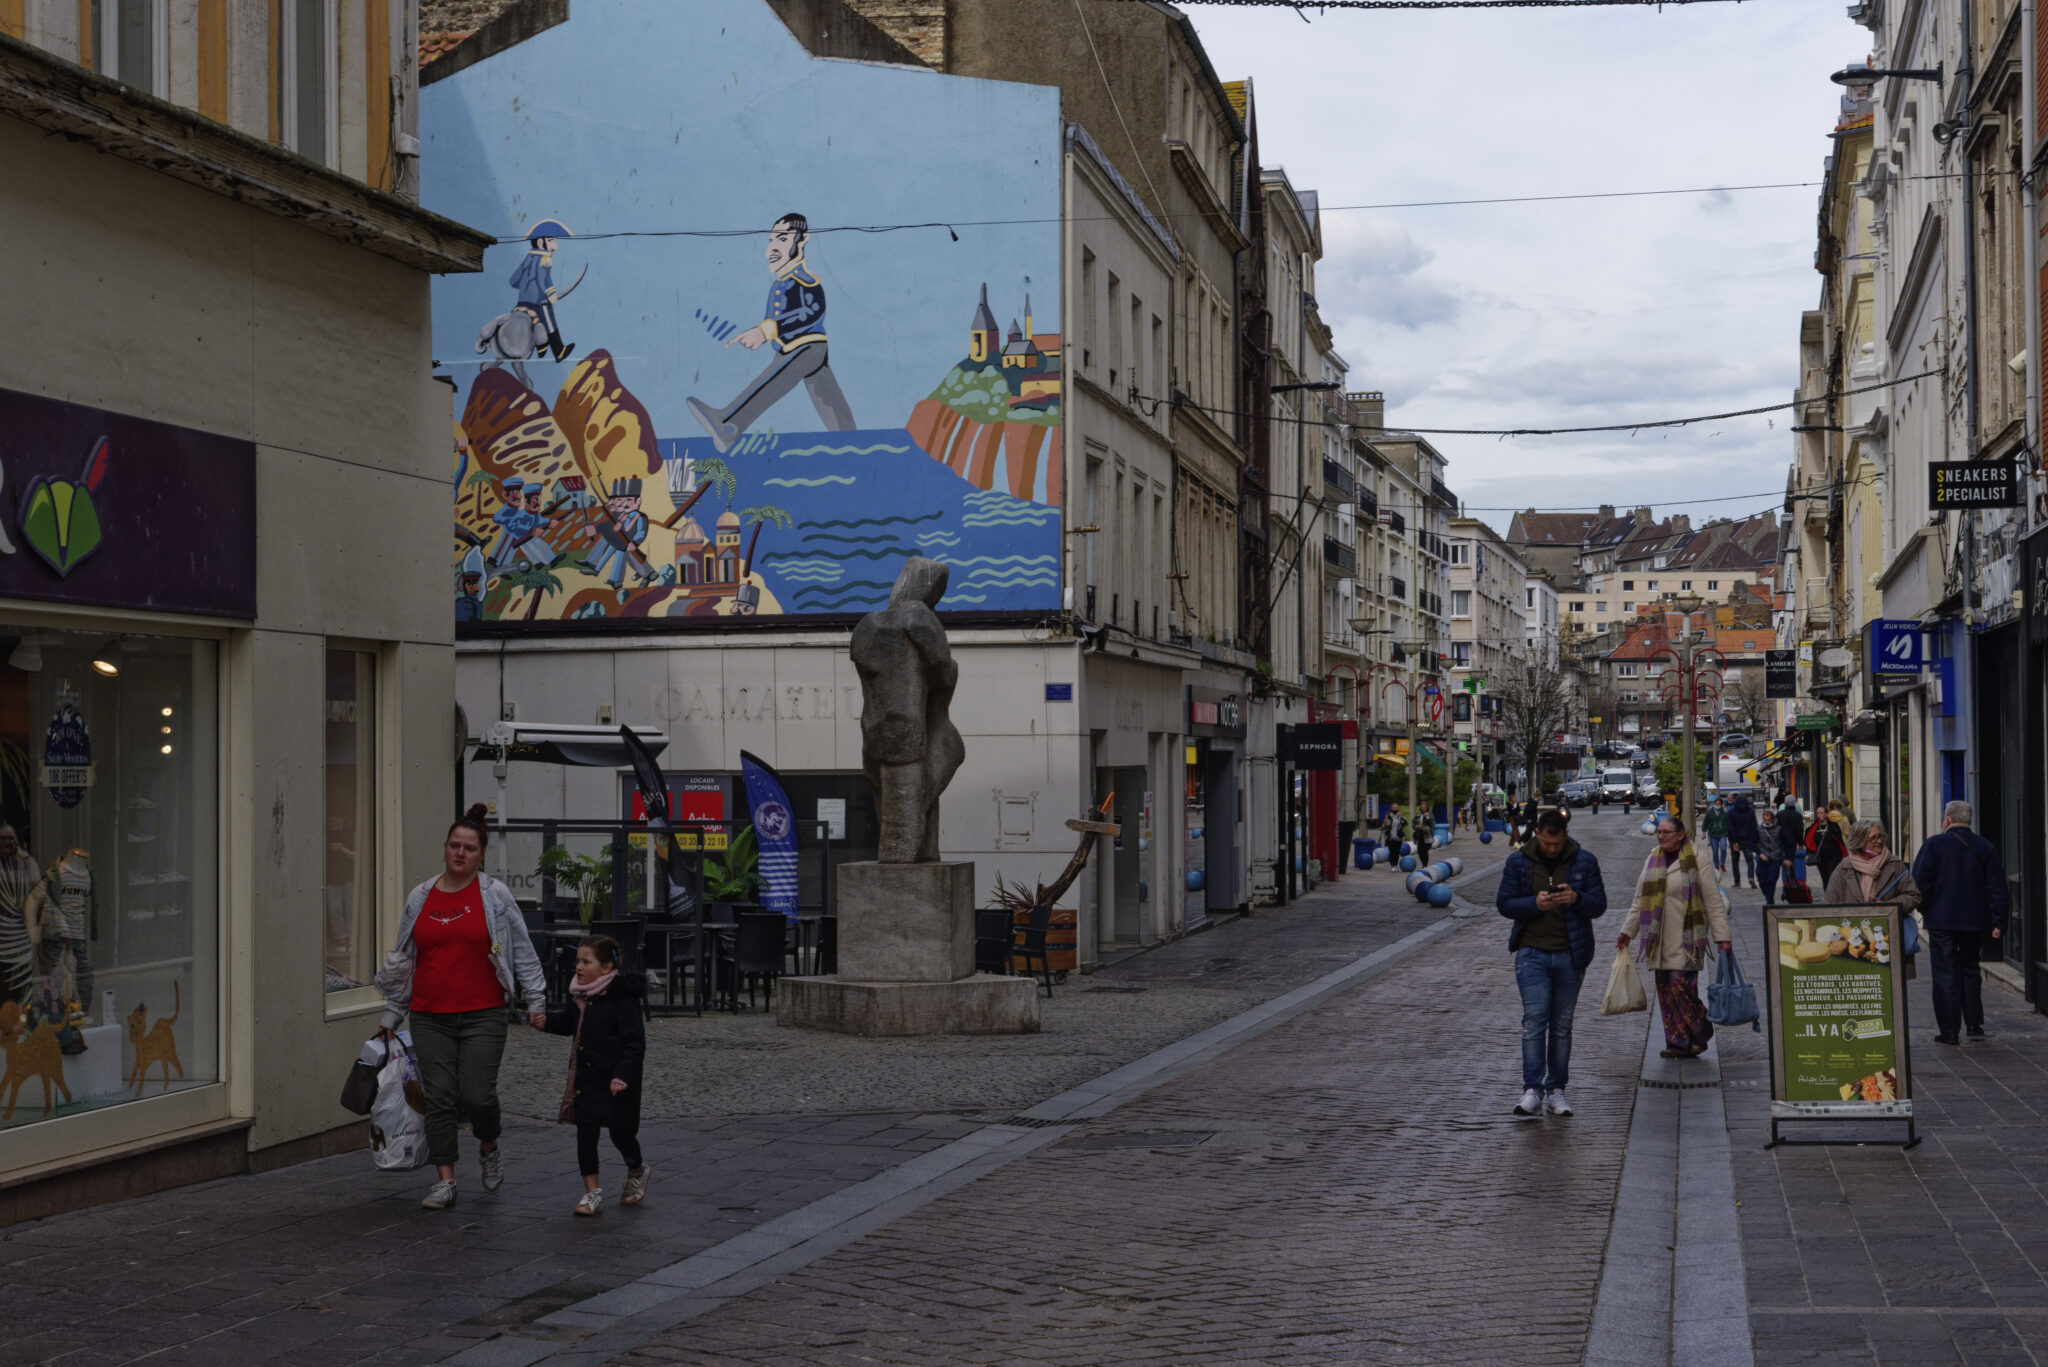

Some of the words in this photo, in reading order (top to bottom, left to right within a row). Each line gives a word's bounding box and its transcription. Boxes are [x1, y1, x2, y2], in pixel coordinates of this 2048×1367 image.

[1937, 468, 2007, 482] SNEAKERS
[62, 768, 88, 784] OFFERTS
[679, 837, 688, 845] 03
[688, 837, 698, 845] 20
[708, 837, 717, 845] 22
[718, 836, 726, 845] 18
[1819, 1024, 1827, 1036] Y
[1830, 1024, 1839, 1036] A
